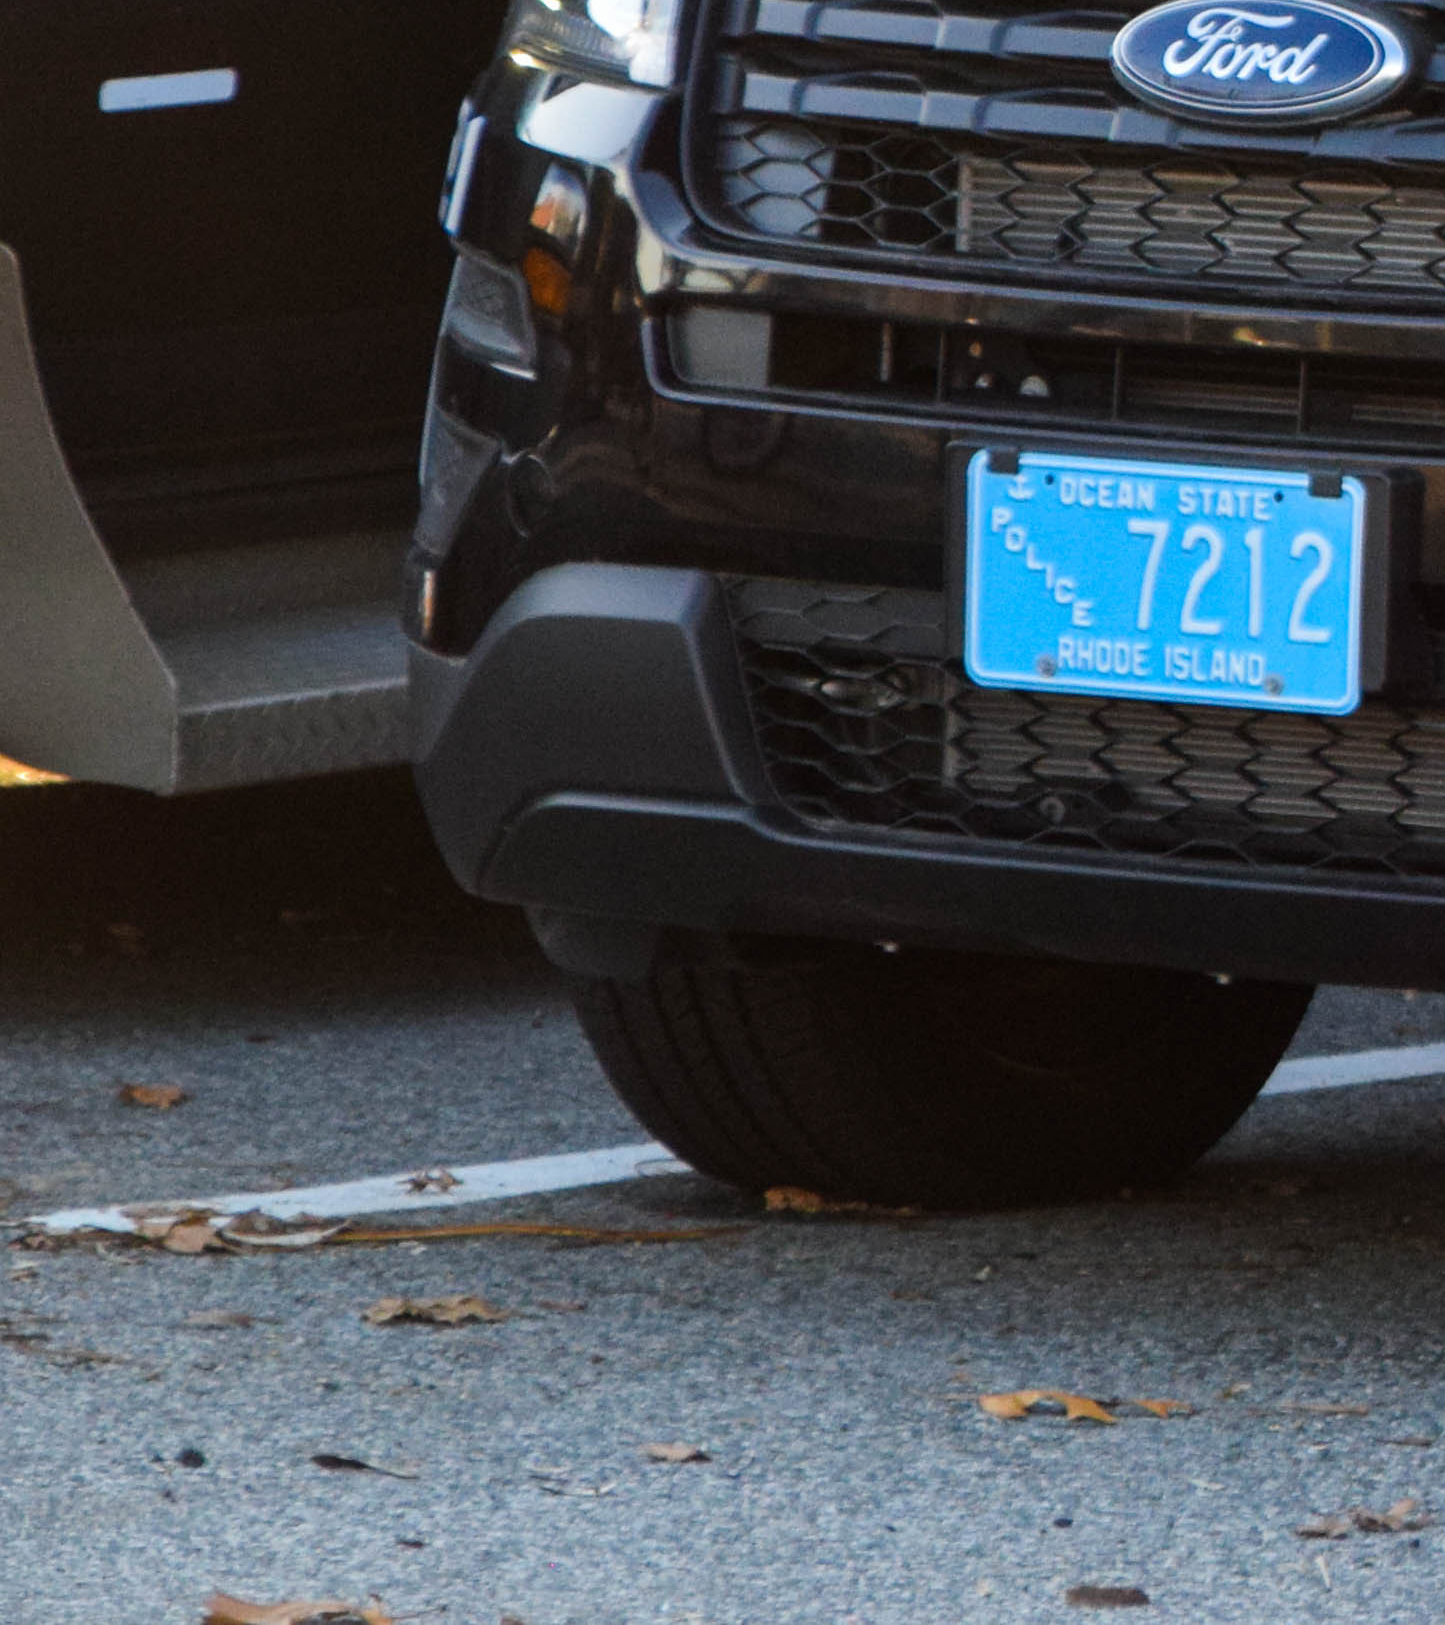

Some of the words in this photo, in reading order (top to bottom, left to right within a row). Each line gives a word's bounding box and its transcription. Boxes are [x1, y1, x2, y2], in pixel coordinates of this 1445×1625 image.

[1162, 6, 1330, 85] Ford
[1059, 476, 1156, 511] OCEAN
[1177, 485, 1273, 521] STATE
[990, 505, 1094, 628] POLICE
[1127, 519, 1333, 643] 7212
[1058, 637, 1149, 676] RHODE
[1163, 644, 1267, 686] ISLAND
